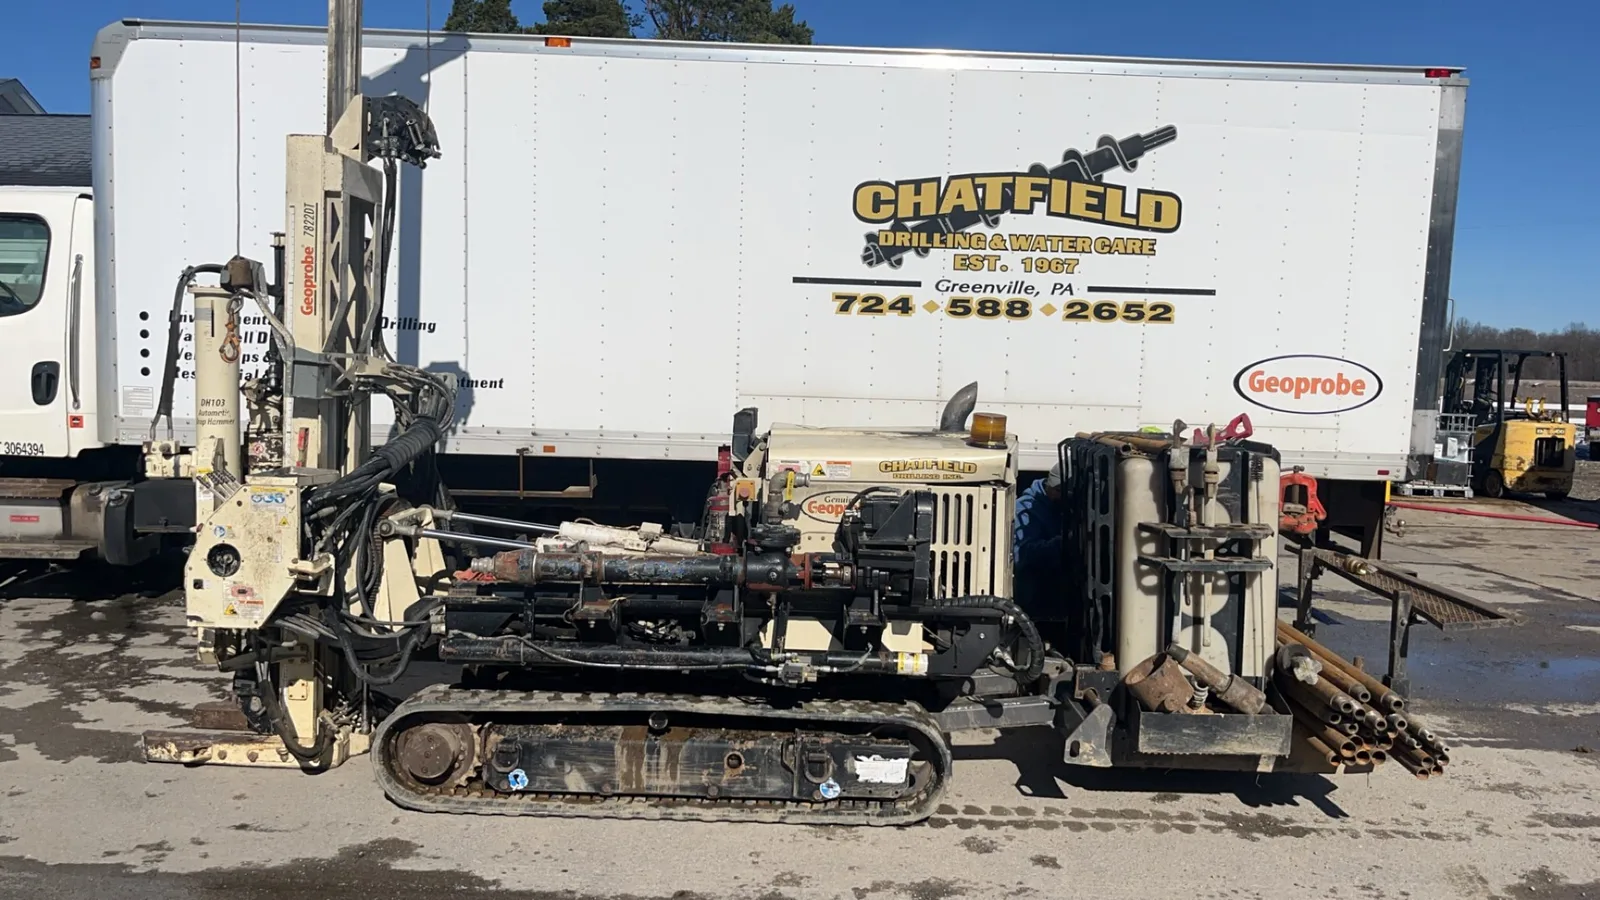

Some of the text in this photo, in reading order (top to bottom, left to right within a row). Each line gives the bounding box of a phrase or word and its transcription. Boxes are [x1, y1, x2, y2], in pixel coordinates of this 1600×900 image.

[853, 172, 1182, 233] CHATFIELD
[878, 230, 1156, 256] DRILLING & WATER CARE
[301, 202, 317, 315] Geoprobe 7822DT
[953, 254, 1079, 274] EST. 1967
[934, 279, 1075, 297] Greenville, PA
[832, 292, 1175, 324] 724 588 2652
[381, 316, 436, 333] Drilling
[457, 378, 504, 389] tment
[1249, 370, 1366, 399] Geoprobe
[200, 398, 226, 407] DH103
[4, 441, 44, 456] 3064394
[879, 459, 978, 474] CHATFIELD
[824, 495, 853, 504] Genui
